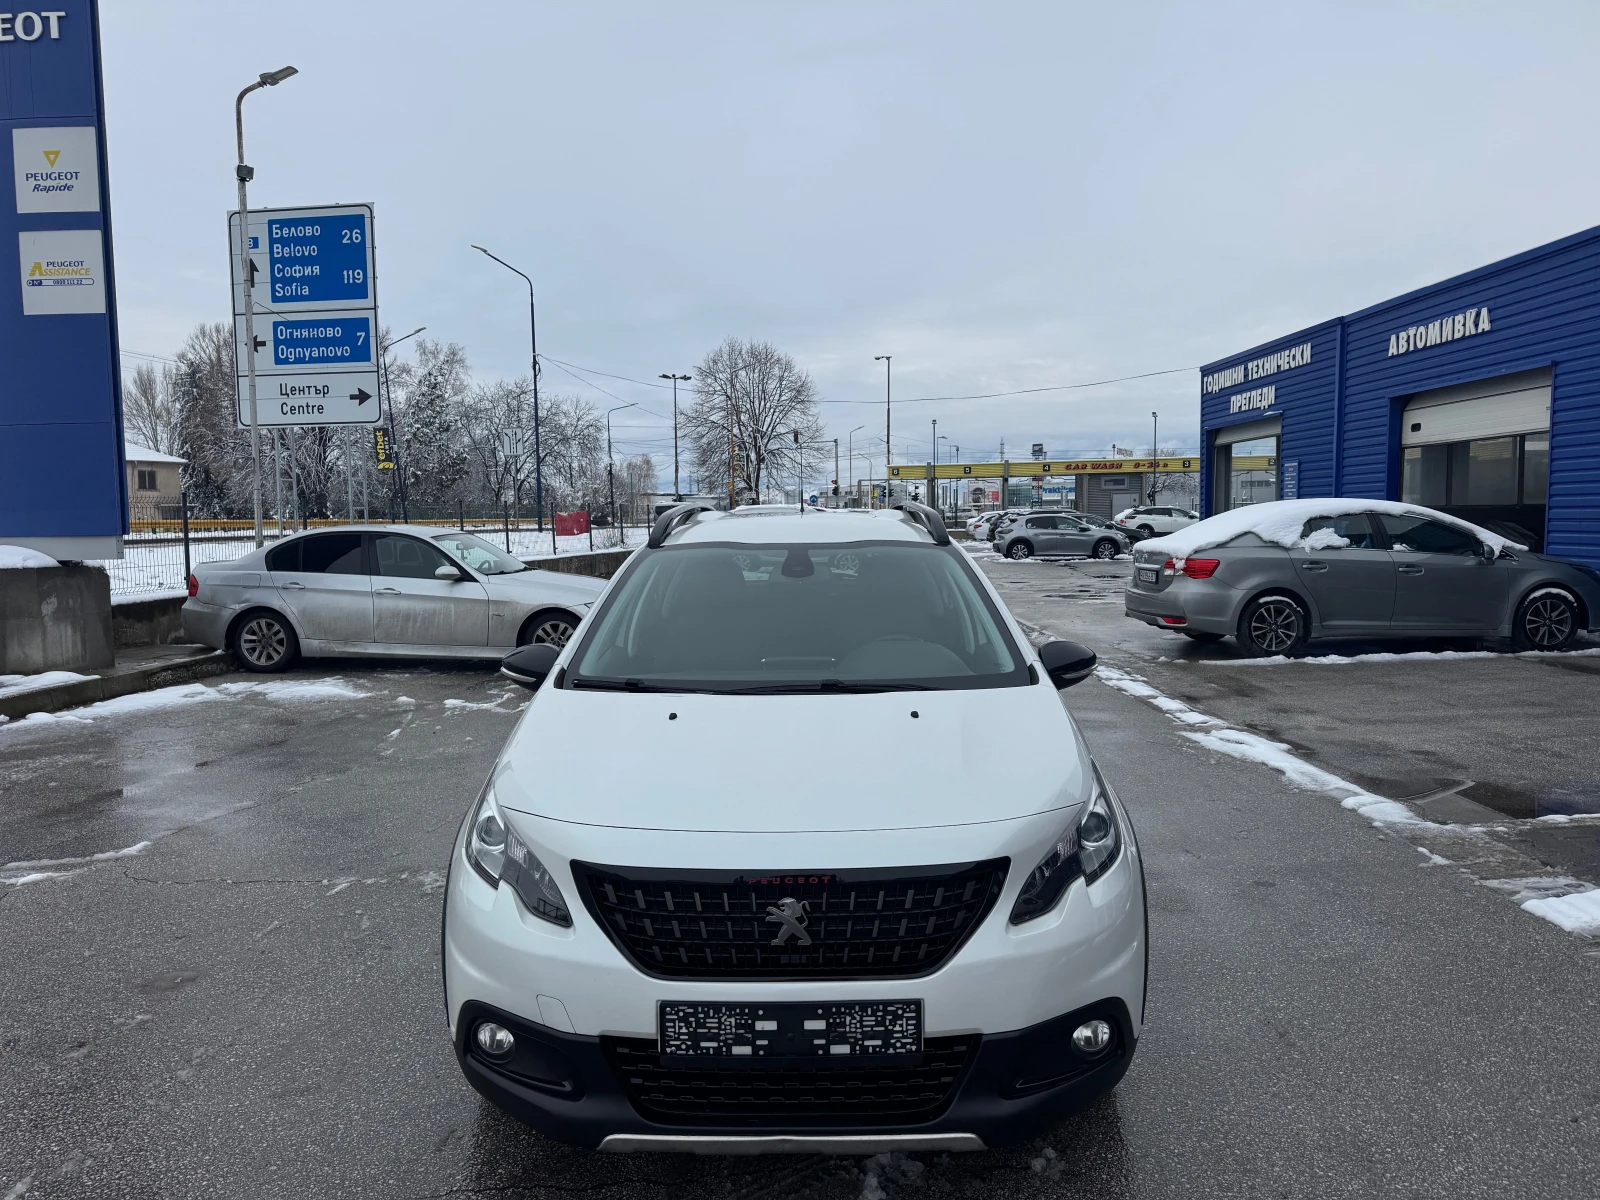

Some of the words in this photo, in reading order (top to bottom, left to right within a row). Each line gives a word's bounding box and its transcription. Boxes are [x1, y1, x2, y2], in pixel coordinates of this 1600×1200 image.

[25, 171, 80, 182] PEUGEOT
[32, 183, 74, 193] Rapide
[272, 224, 321, 238] Белово
[341, 229, 362, 244] 26
[273, 243, 318, 258] Belovo
[29, 261, 91, 277] ASSISTANCE
[46, 260, 85, 268] PEUGEOT
[274, 263, 320, 278] София
[342, 269, 364, 284] 119
[275, 282, 309, 297] Sofia
[277, 325, 342, 339] Огняново
[356, 331, 366, 346] 7
[1387, 306, 1492, 357] АВТОМИВКА
[278, 345, 351, 362] Ognyanovo
[1203, 364, 1245, 394] ГОДИШНИ
[1247, 342, 1312, 381] ТЕХНИЧЕСКИ
[279, 382, 330, 398] Център
[1230, 384, 1276, 414] ПРЕГЛЕДИ
[280, 401, 325, 415] Centre
[1065, 463, 1088, 471] CAR
[1091, 462, 1123, 470] WASH
[748, 876, 831, 884] PEUGEOT
